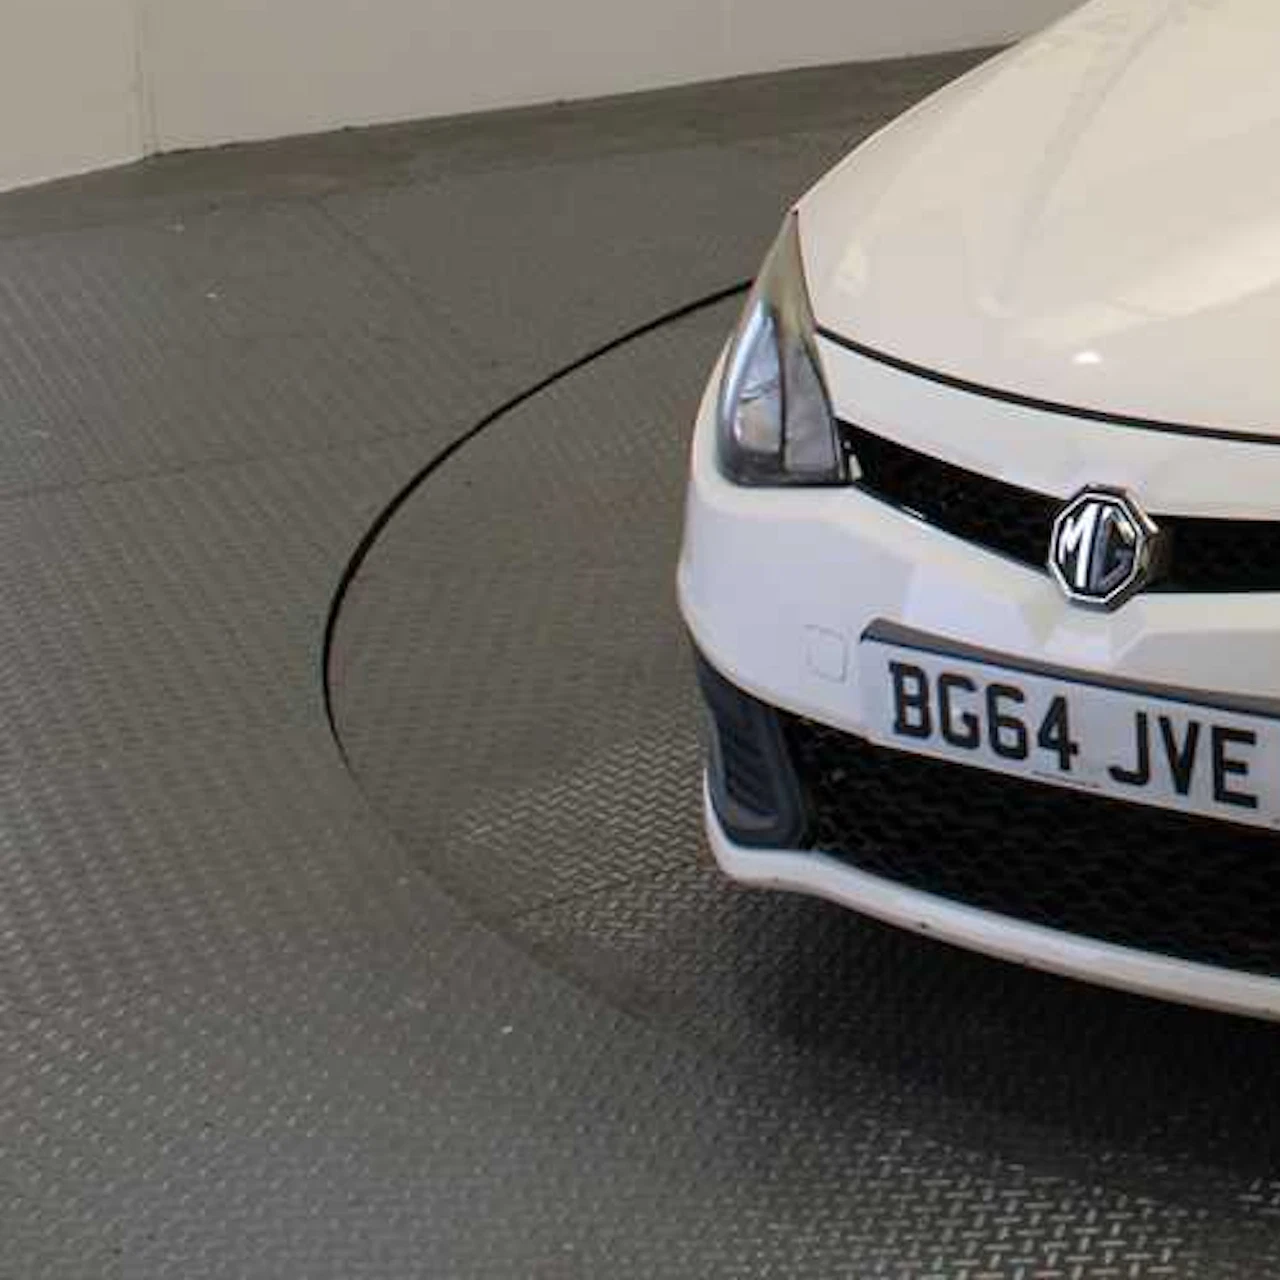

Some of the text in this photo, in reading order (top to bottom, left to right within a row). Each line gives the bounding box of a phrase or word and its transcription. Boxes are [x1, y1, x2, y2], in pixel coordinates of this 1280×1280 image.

[1057, 502, 1137, 591] MG
[888, 659, 1259, 810] BG64 JVE
